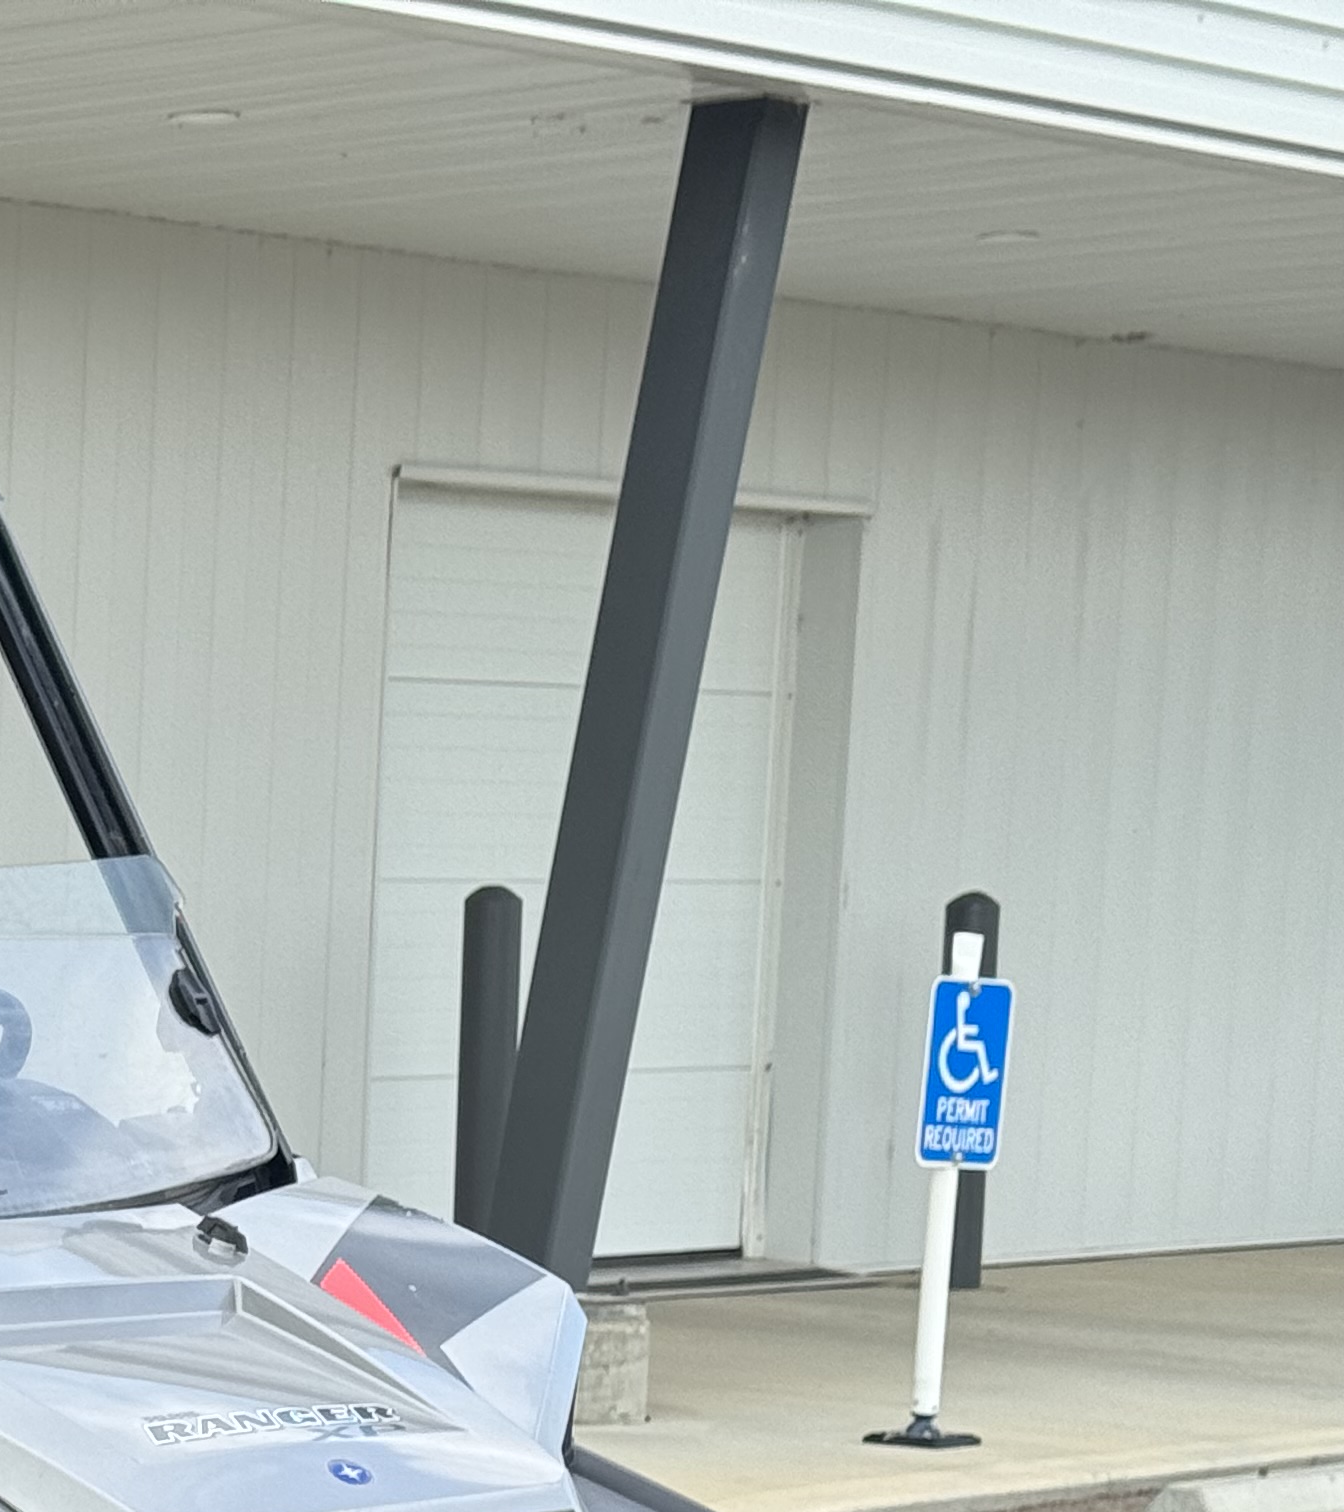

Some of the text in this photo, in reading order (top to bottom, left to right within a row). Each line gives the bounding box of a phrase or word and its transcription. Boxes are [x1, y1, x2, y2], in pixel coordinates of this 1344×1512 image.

[936, 1097, 990, 1123] PERMIT
[923, 1124, 995, 1154] REQUIRED
[143, 1403, 401, 1446] RANGER
[311, 1423, 407, 1442] XP
